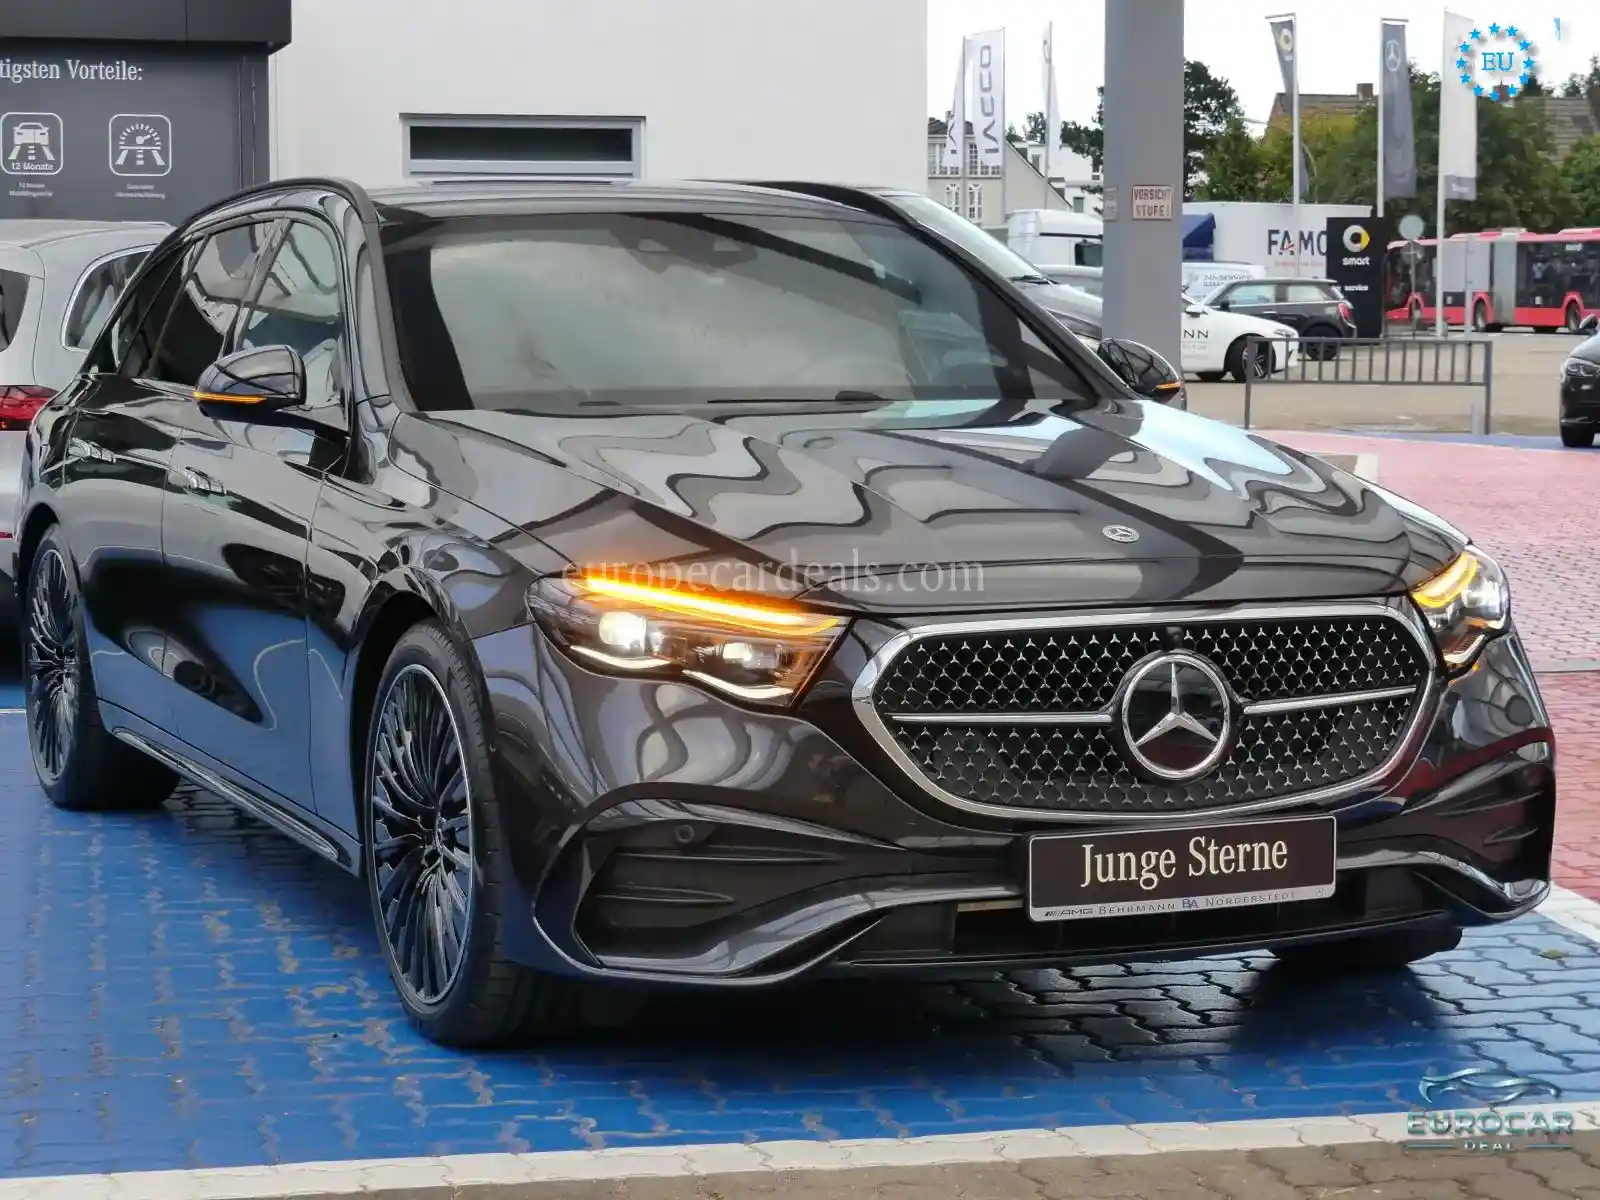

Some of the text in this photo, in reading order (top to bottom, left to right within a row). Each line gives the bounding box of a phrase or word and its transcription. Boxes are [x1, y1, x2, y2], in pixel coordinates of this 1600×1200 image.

[0, 59, 144, 83] tigsten Vorteile:
[11, 162, 54, 171] 12 Monate
[1133, 189, 1172, 200] VORSICHT
[1135, 205, 1170, 216] STUFE!
[1342, 256, 1370, 266] smart
[1080, 836, 1289, 891] Junge Sterne
[1058, 907, 1095, 917] AMG
[1098, 902, 1177, 916] BEHRMANN
